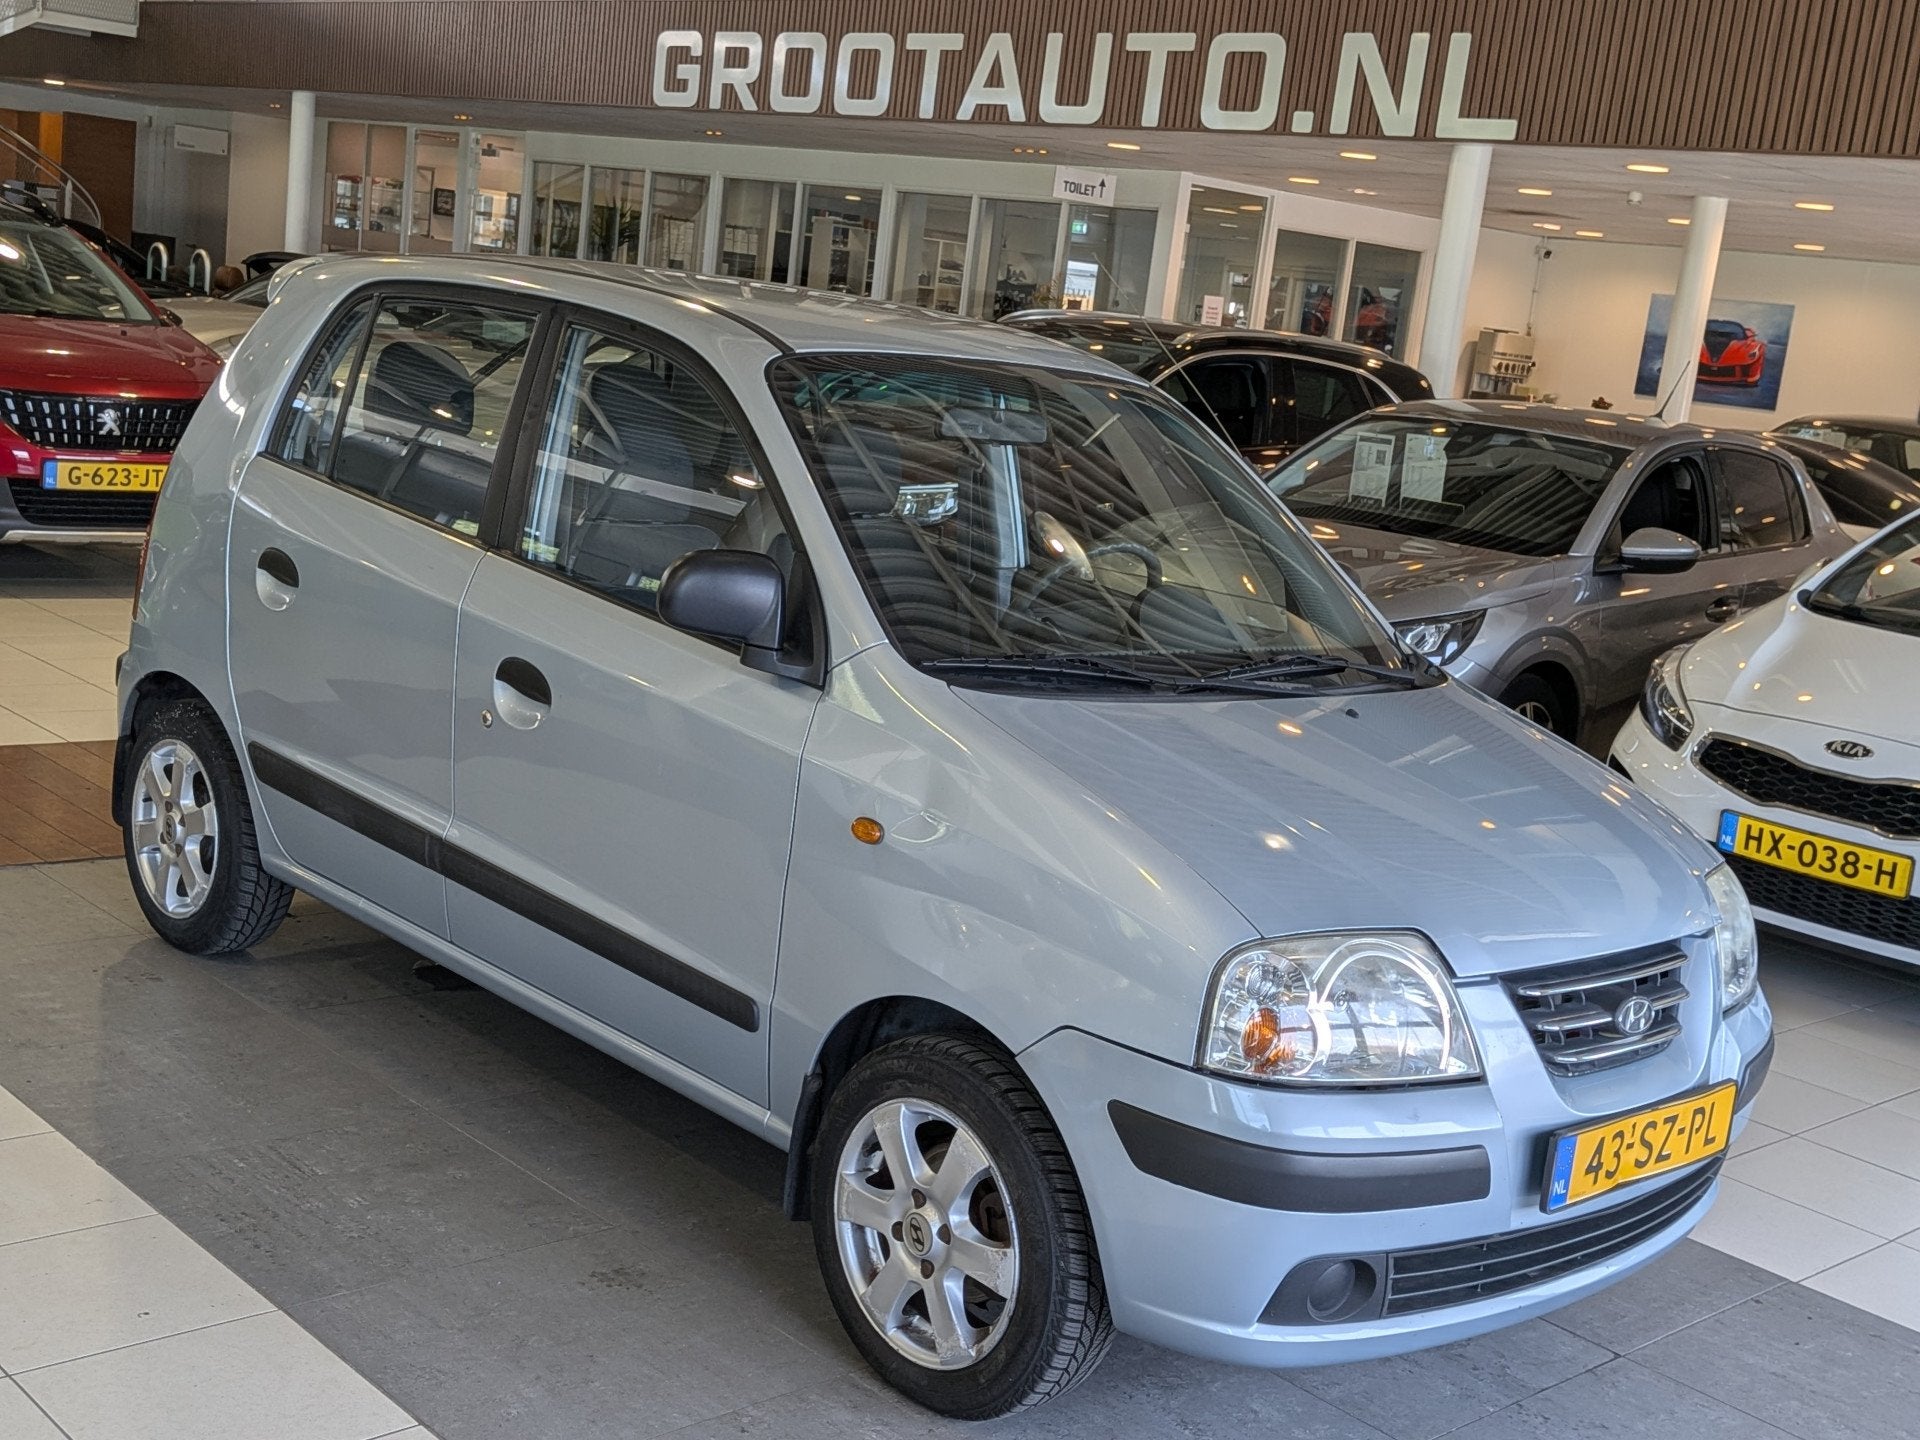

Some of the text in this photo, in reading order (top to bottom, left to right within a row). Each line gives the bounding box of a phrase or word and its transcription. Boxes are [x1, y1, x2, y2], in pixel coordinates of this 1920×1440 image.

[652, 31, 1518, 140] GROOTAUTO.NL
[1063, 180, 1096, 197] TOILET
[46, 477, 56, 485] NL
[67, 466, 163, 488] G-623-JT
[1830, 740, 1866, 757] KIA
[1721, 834, 1733, 846] NL
[1743, 824, 1898, 890] HX-038-H
[1553, 1181, 1567, 1196] NL
